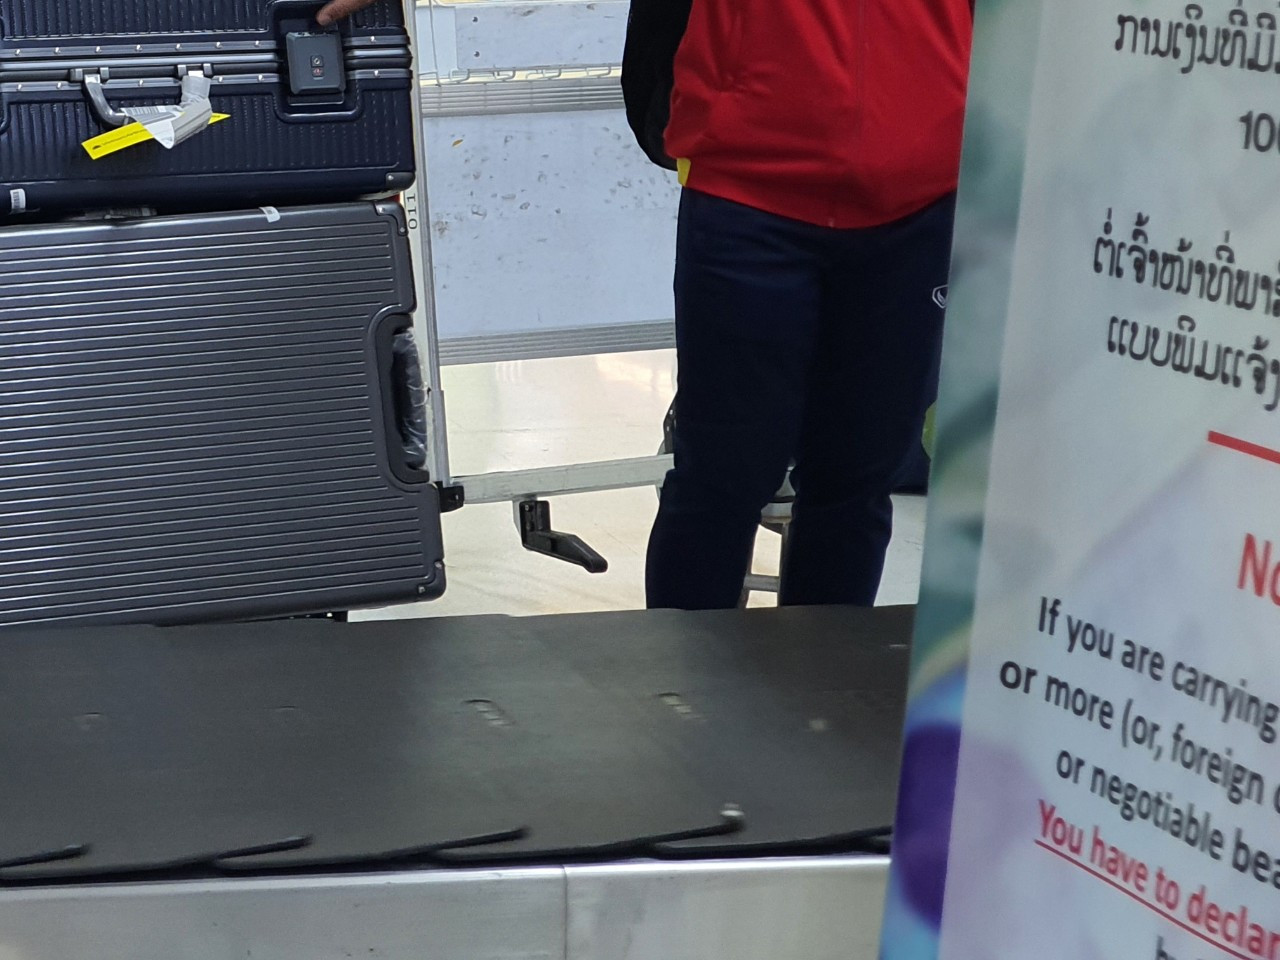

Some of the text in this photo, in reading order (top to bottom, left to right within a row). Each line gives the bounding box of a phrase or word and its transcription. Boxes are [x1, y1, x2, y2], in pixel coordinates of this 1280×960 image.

[1239, 110, 1280, 153] 10
[1038, 596, 1279, 743] If you are carrying
[999, 660, 1037, 695] or
[1045, 673, 1114, 731] more
[1121, 698, 1163, 762] (or,
[1171, 723, 1264, 805] foreign
[1038, 799, 1084, 857] You
[1090, 826, 1149, 894] have
[1155, 867, 1179, 911] to
[1056, 749, 1084, 785] or
[1090, 762, 1224, 861] negotiable
